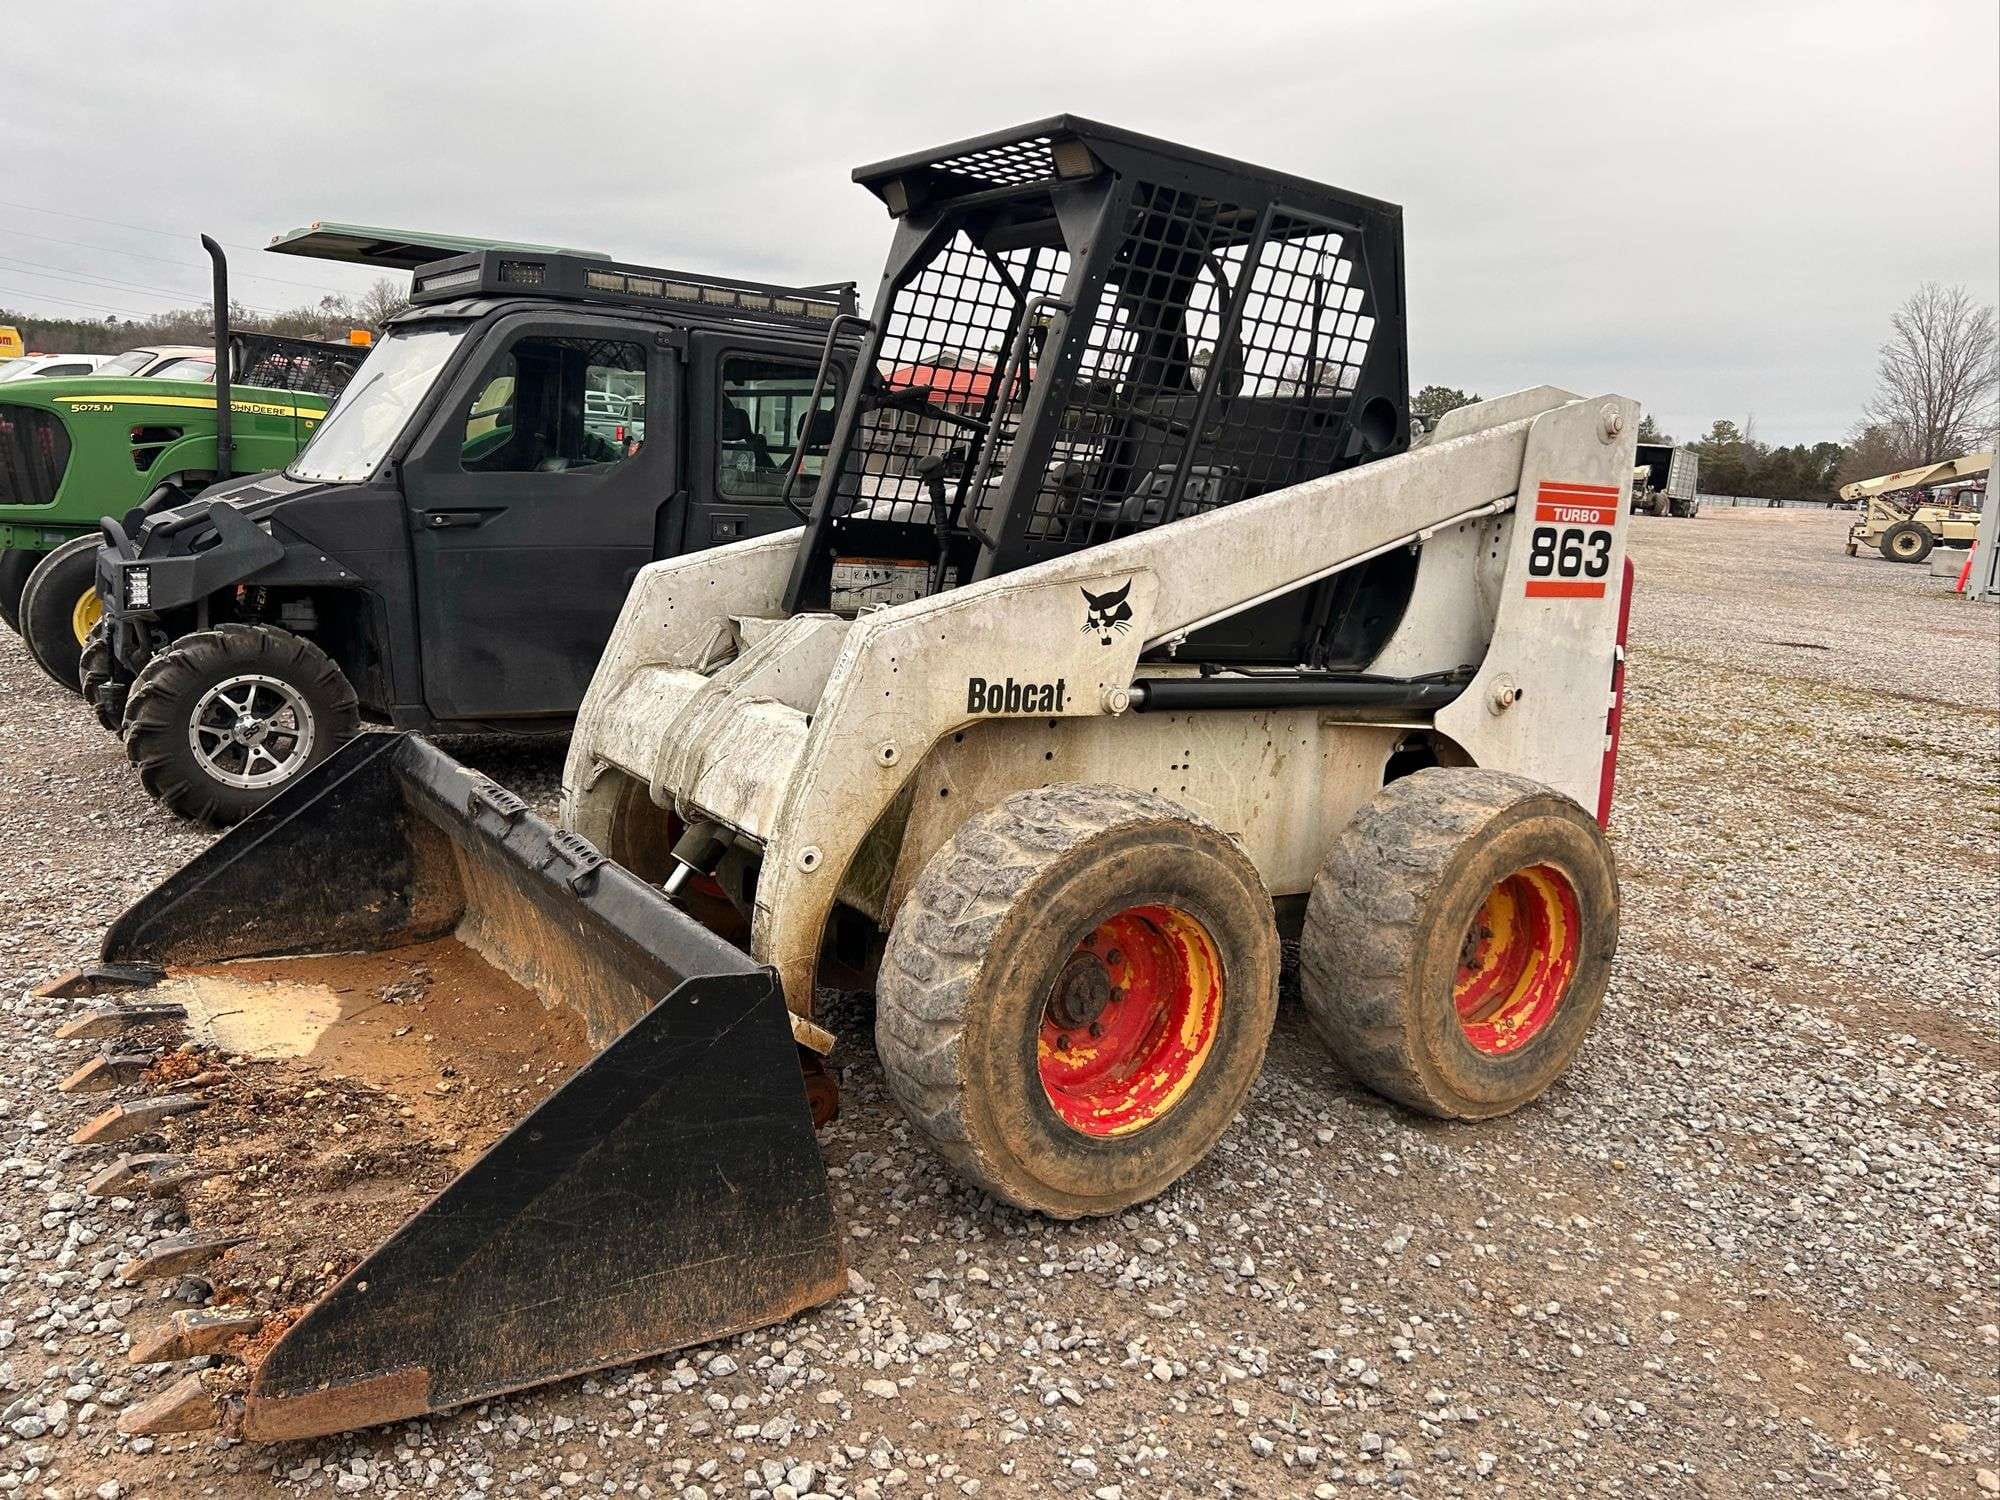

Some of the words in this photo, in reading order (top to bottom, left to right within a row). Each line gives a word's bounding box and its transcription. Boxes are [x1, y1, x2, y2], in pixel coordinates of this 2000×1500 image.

[71, 404, 101, 413] 5075
[103, 404, 114, 412] M
[229, 403, 252, 413] OHN
[252, 404, 287, 416] DEERE
[1553, 507, 1600, 523] TURBO
[1529, 527, 1612, 577] 863
[967, 677, 1066, 714] Bobcat
